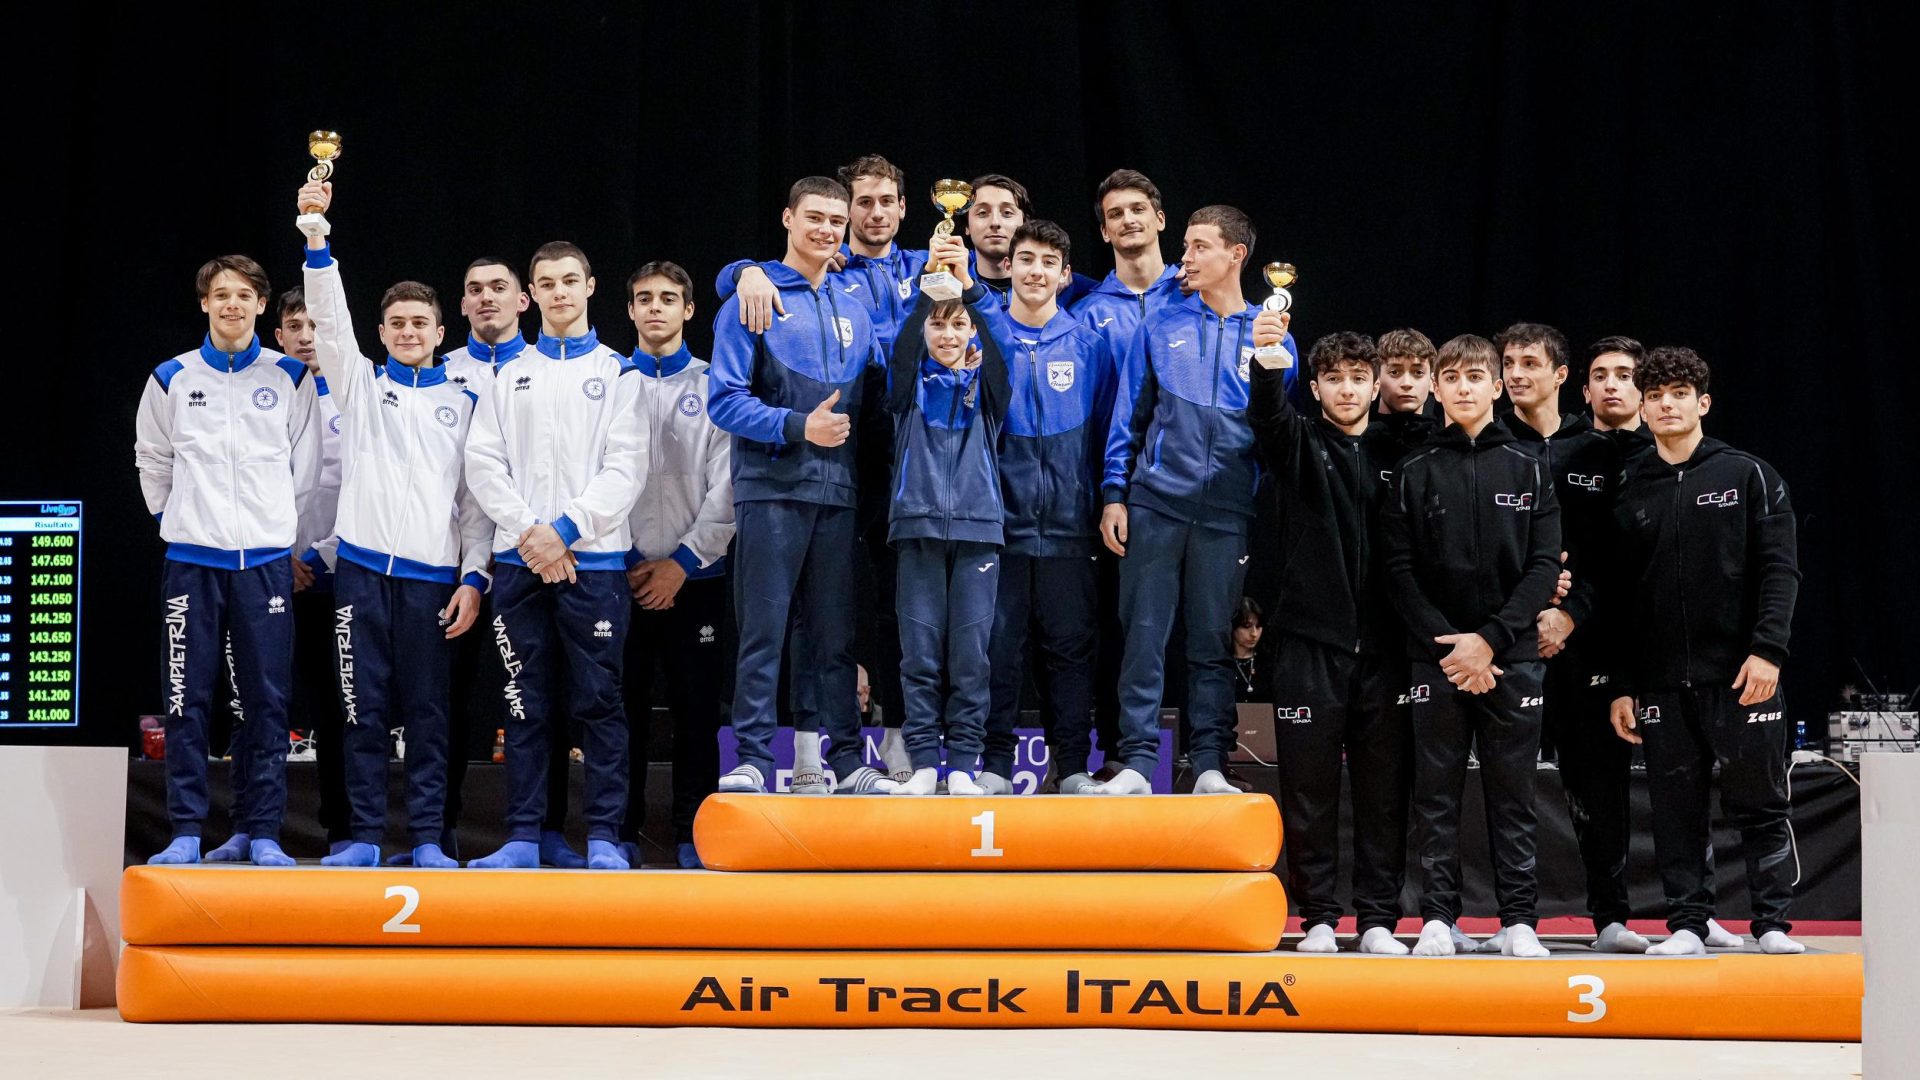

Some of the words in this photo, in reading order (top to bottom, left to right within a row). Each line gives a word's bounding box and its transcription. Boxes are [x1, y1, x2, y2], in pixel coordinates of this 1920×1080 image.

[34, 521, 73, 529] Risultato
[32, 535, 73, 547] 149.600
[31, 555, 73, 566] 147.650
[31, 574, 73, 586] 147.100
[30, 593, 72, 605] 145.050
[30, 612, 72, 624] 144.250
[29, 631, 72, 644] 143.650
[29, 651, 71, 662] 143.250
[165, 594, 190, 717] SAMPIETRINA
[335, 604, 358, 725] SAMPIETRINA
[28, 670, 71, 682] 142.150
[28, 689, 70, 702] 141.200
[28, 708, 70, 721] 141.000
[1746, 711, 1782, 724] Zeus
[970, 810, 1004, 857] 1
[382, 885, 421, 933] 2
[680, 976, 790, 1012] Air
[818, 977, 1028, 1013] Track
[1567, 974, 1607, 1023] 3
